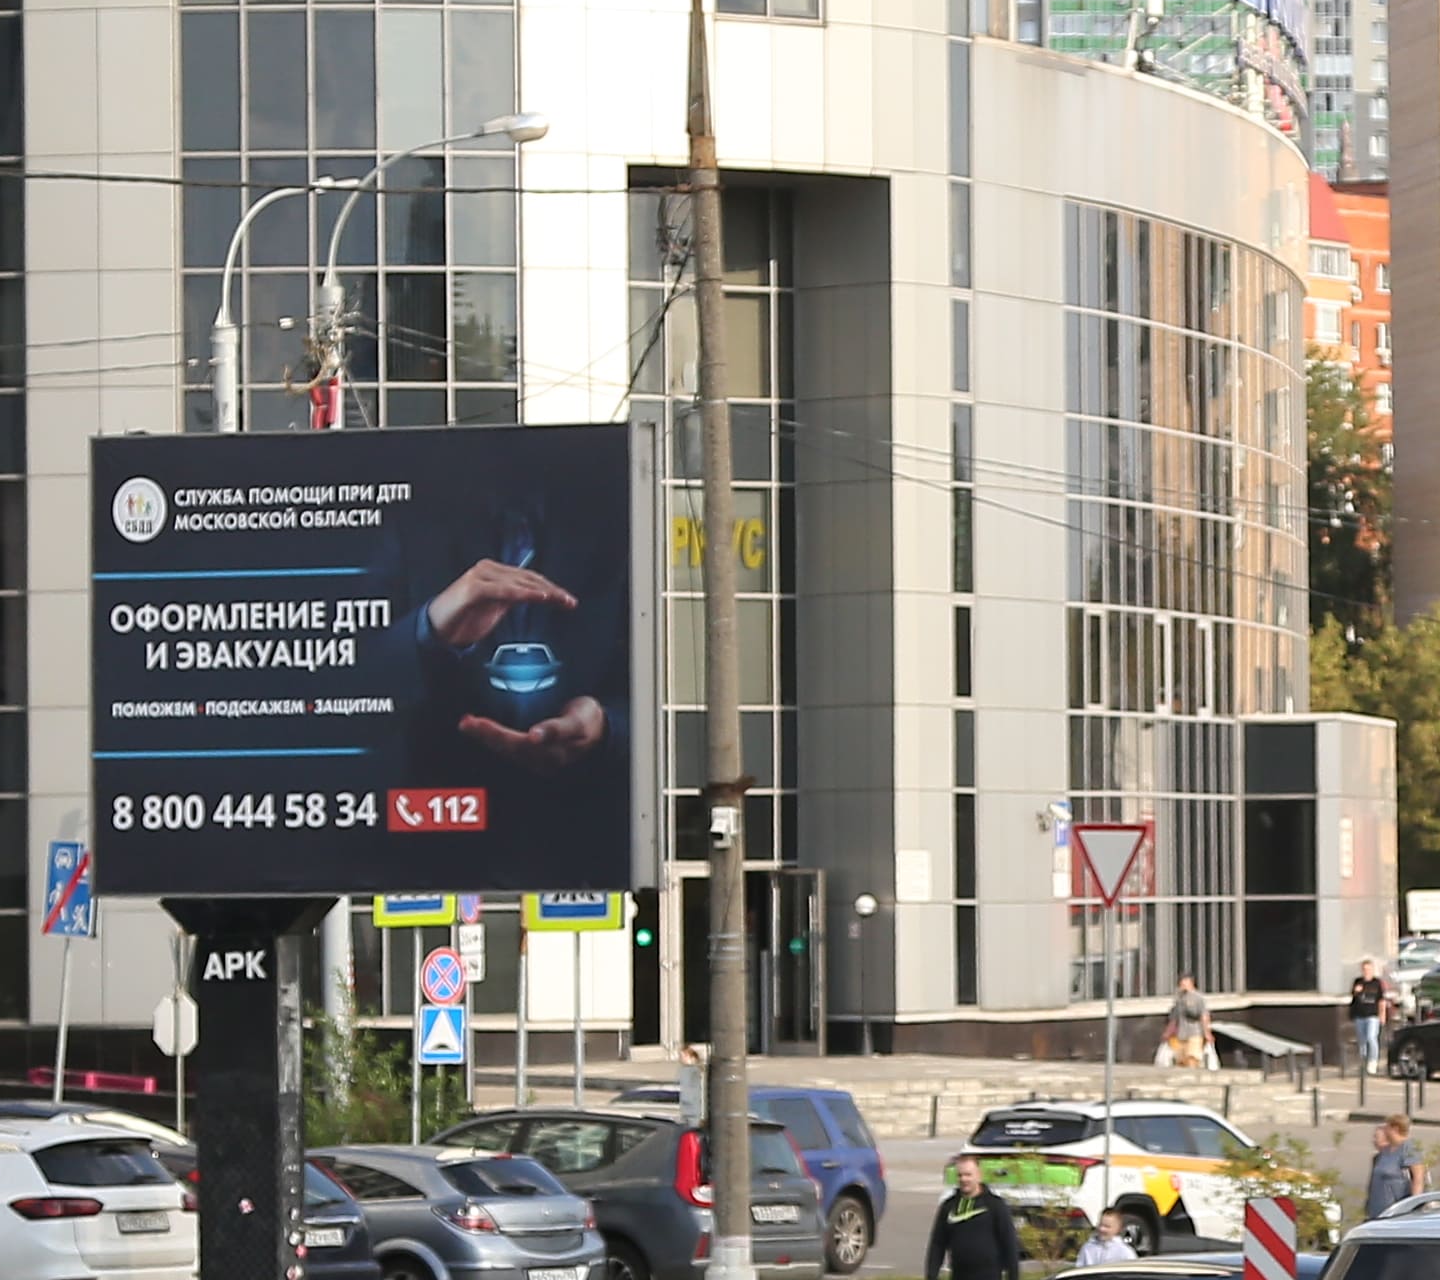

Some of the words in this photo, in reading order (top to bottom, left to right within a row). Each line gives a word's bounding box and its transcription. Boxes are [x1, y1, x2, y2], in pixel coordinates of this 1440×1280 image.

[174, 488, 246, 507] СЛУЖБА
[248, 485, 334, 506] ПОМОЩИ
[338, 484, 374, 503] ПРИ
[376, 483, 411, 503] ДТП
[174, 507, 296, 531] МОСКОВСКОЙ
[300, 509, 382, 529] ОБЛАСТИ
[109, 600, 327, 633] ОФОРМЛЕНИЕ
[333, 598, 391, 634] ДТП
[146, 641, 168, 670] И
[175, 638, 356, 672] ЭВАКУАЦИЯ
[111, 701, 197, 718] ПОМОЖЕМ
[204, 699, 305, 718] ПОДСКАЖЕМ
[313, 697, 394, 716] ЗАЩИТИМ
[112, 795, 134, 831] 8
[142, 793, 205, 830] 800
[212, 793, 277, 829] 444
[284, 791, 327, 828] 58
[334, 791, 379, 828] 34
[427, 795, 480, 824] 112
